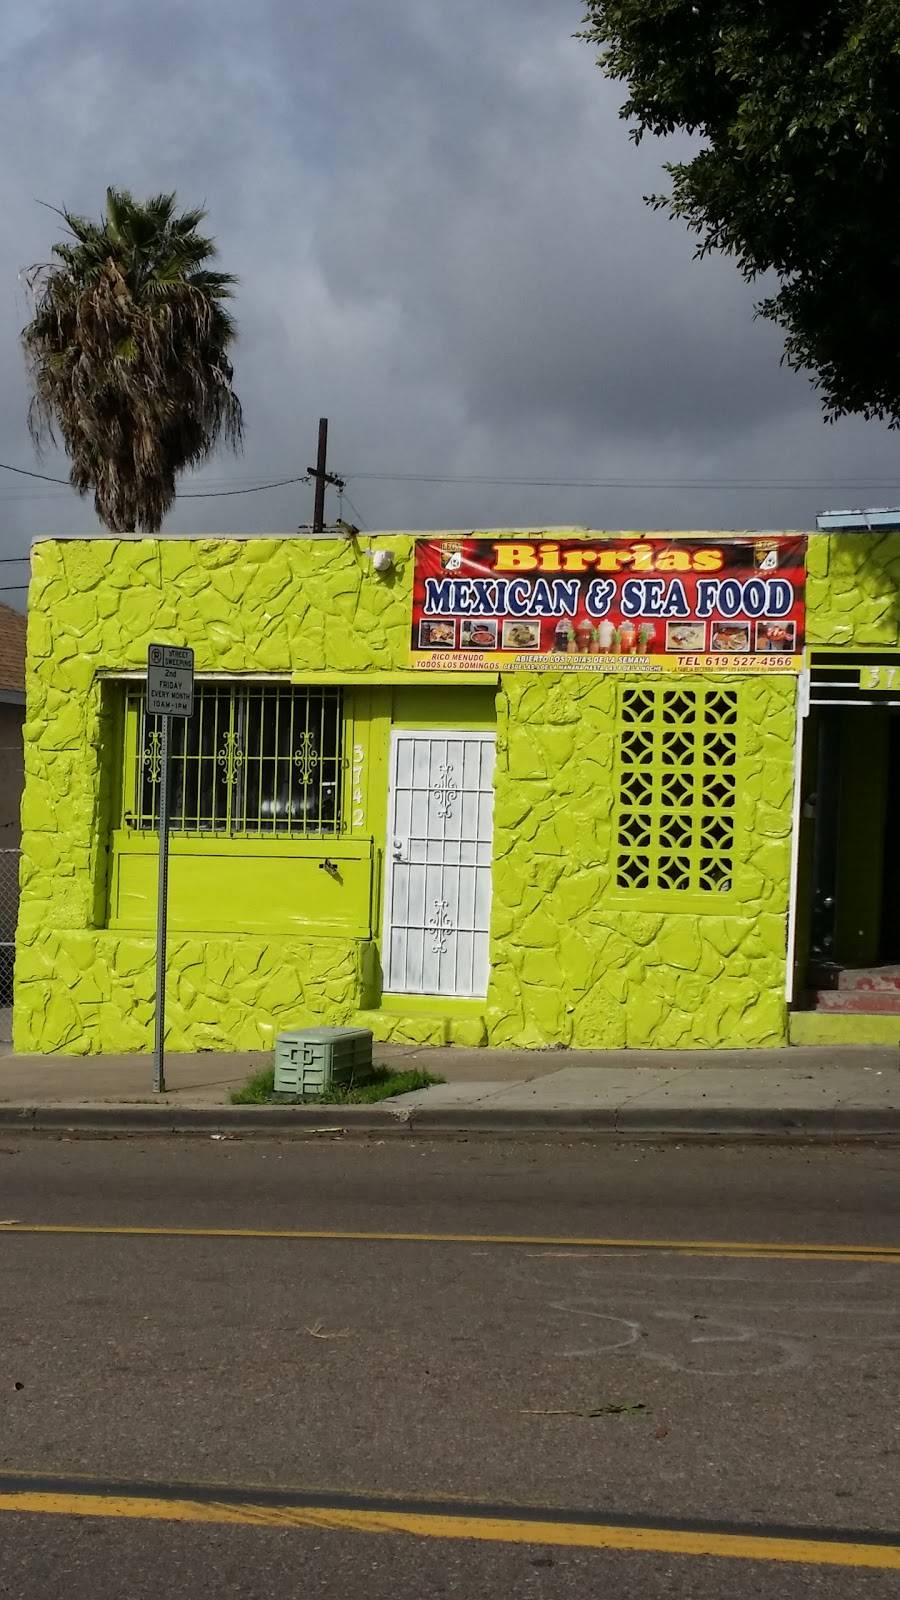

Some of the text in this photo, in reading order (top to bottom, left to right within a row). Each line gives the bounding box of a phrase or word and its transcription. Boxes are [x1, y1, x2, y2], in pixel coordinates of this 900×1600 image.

[493, 543, 724, 573] Birrias
[424, 578, 795, 618] MEXICAN & SEA FOOD
[168, 650, 189, 659] STREET
[432, 653, 450, 661] RICO
[515, 655, 549, 663] ABIERTO
[550, 655, 565, 664] LOS
[594, 656, 605, 664] DE
[606, 656, 616, 664] LA
[618, 656, 650, 664] SEMANA
[416, 660, 441, 668] TODOS
[459, 662, 500, 670] DOMINGOS
[678, 656, 792, 667] TEL 619 527-4566
[165, 669, 177, 678] 2nd
[159, 680, 183, 690] FRIDAY
[151, 689, 191, 700] EVERY MONTH
